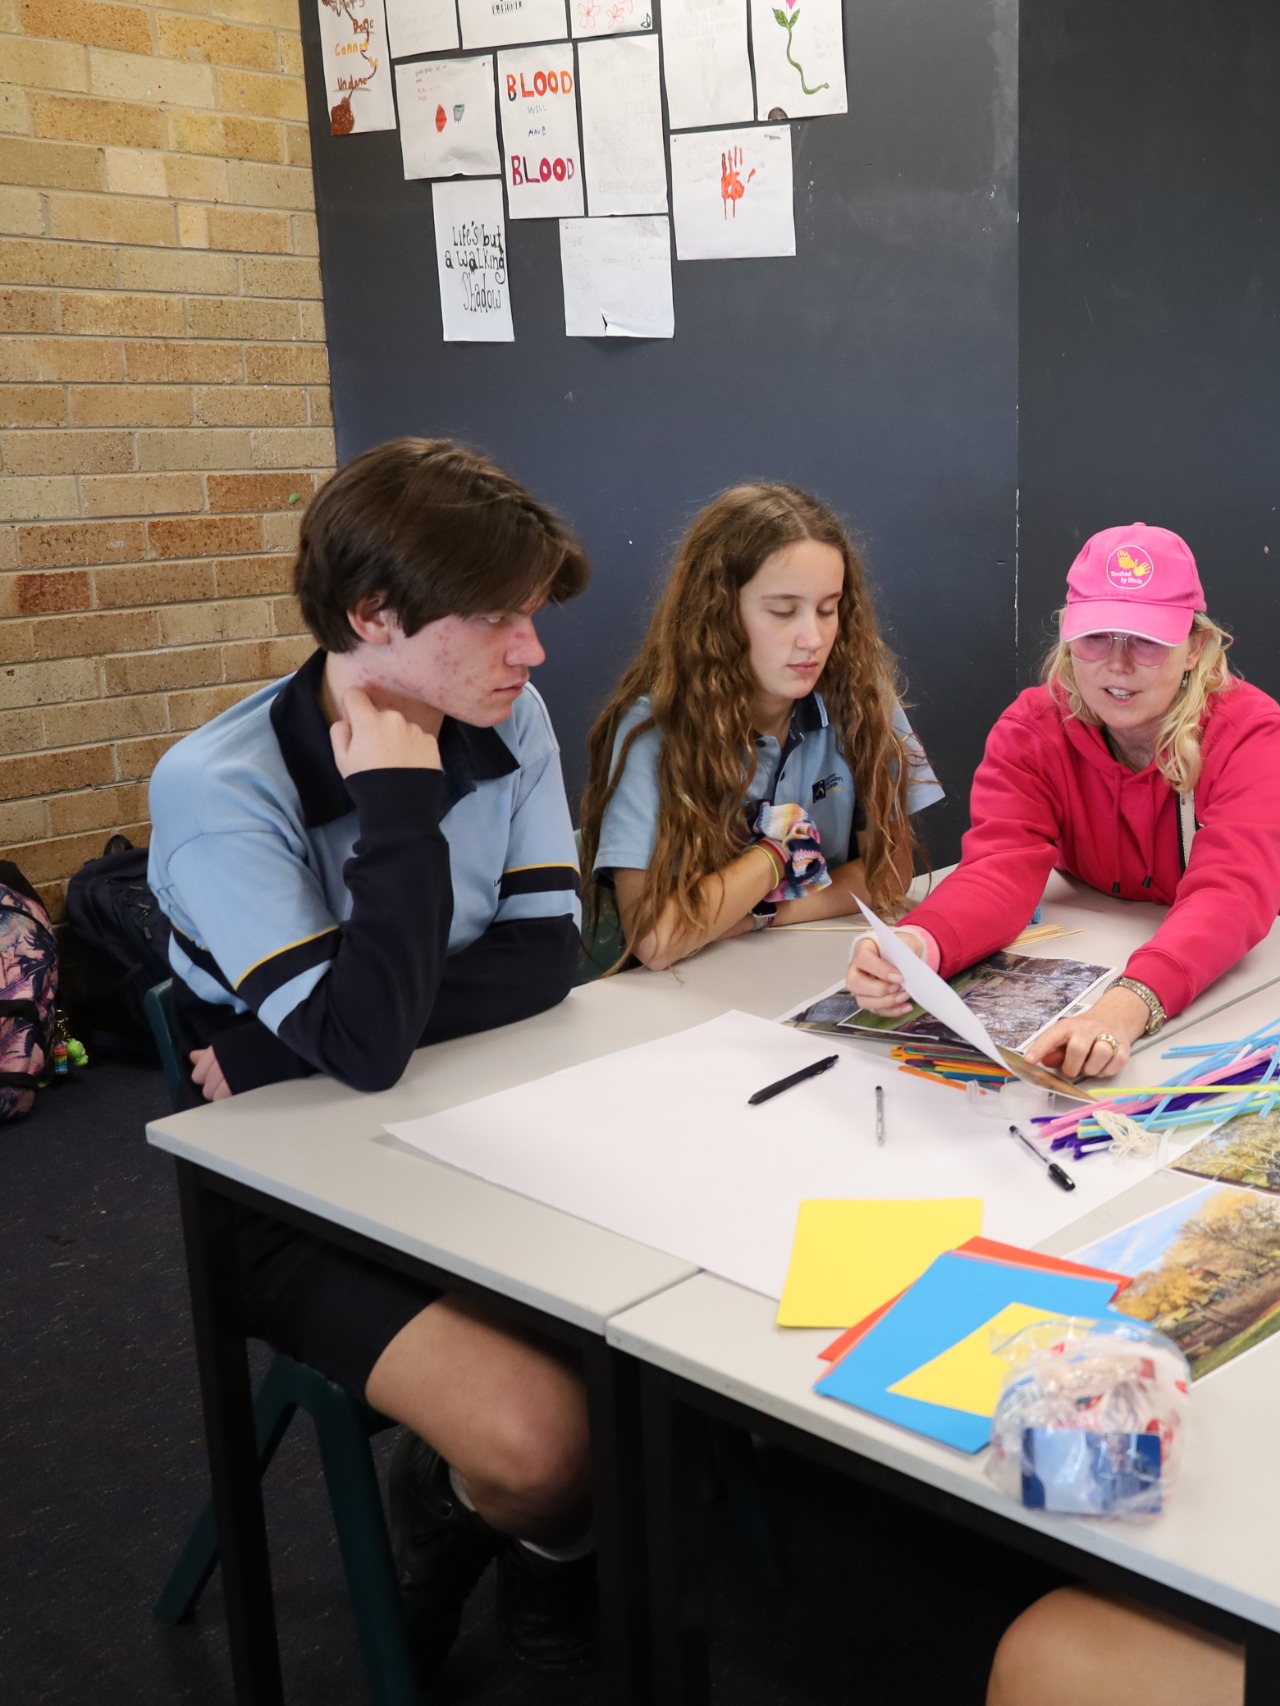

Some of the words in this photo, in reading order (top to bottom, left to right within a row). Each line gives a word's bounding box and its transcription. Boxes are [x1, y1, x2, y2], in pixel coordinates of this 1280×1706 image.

[506, 71, 573, 101] BLOOD
[527, 104, 547, 114] WILL
[511, 155, 575, 186] BLOOD
[481, 224, 503, 250] but
[445, 250, 454, 269] a
